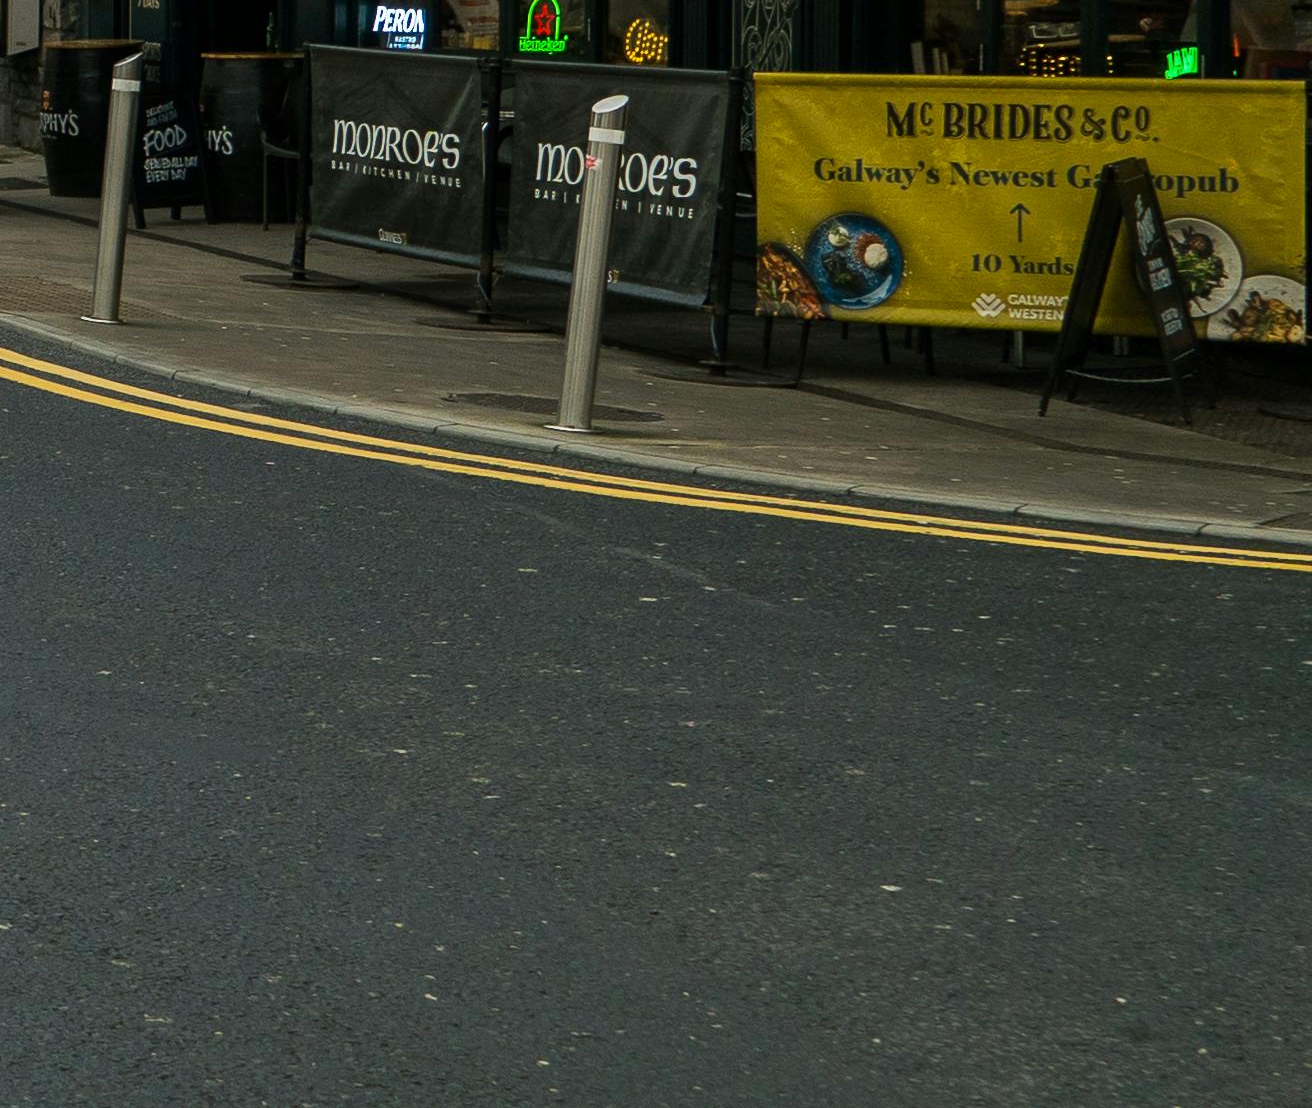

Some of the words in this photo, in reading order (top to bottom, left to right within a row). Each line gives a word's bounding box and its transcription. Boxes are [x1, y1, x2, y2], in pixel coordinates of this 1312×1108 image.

[519, 36, 567, 53] Heineken
[943, 102, 1075, 141] BRIDES
[1080, 108, 1107, 141] &
[142, 124, 187, 157] FOOD
[332, 119, 461, 169] MONROE'S
[146, 169, 169, 183] EVERY
[170, 168, 187, 181] DAY
[331, 159, 351, 171] BAR
[362, 166, 411, 181] KITCHEN
[424, 173, 462, 188] VENUE
[535, 142, 698, 198] MOOE'S
[813, 157, 941, 191] Galway's
[950, 162, 1056, 188] Newest
[1067, 164, 1240, 198] Gaopub
[534, 188, 557, 202] BAR
[649, 204, 695, 220] VENUE
[971, 253, 1002, 273] 10
[1009, 254, 1074, 277] Yards
